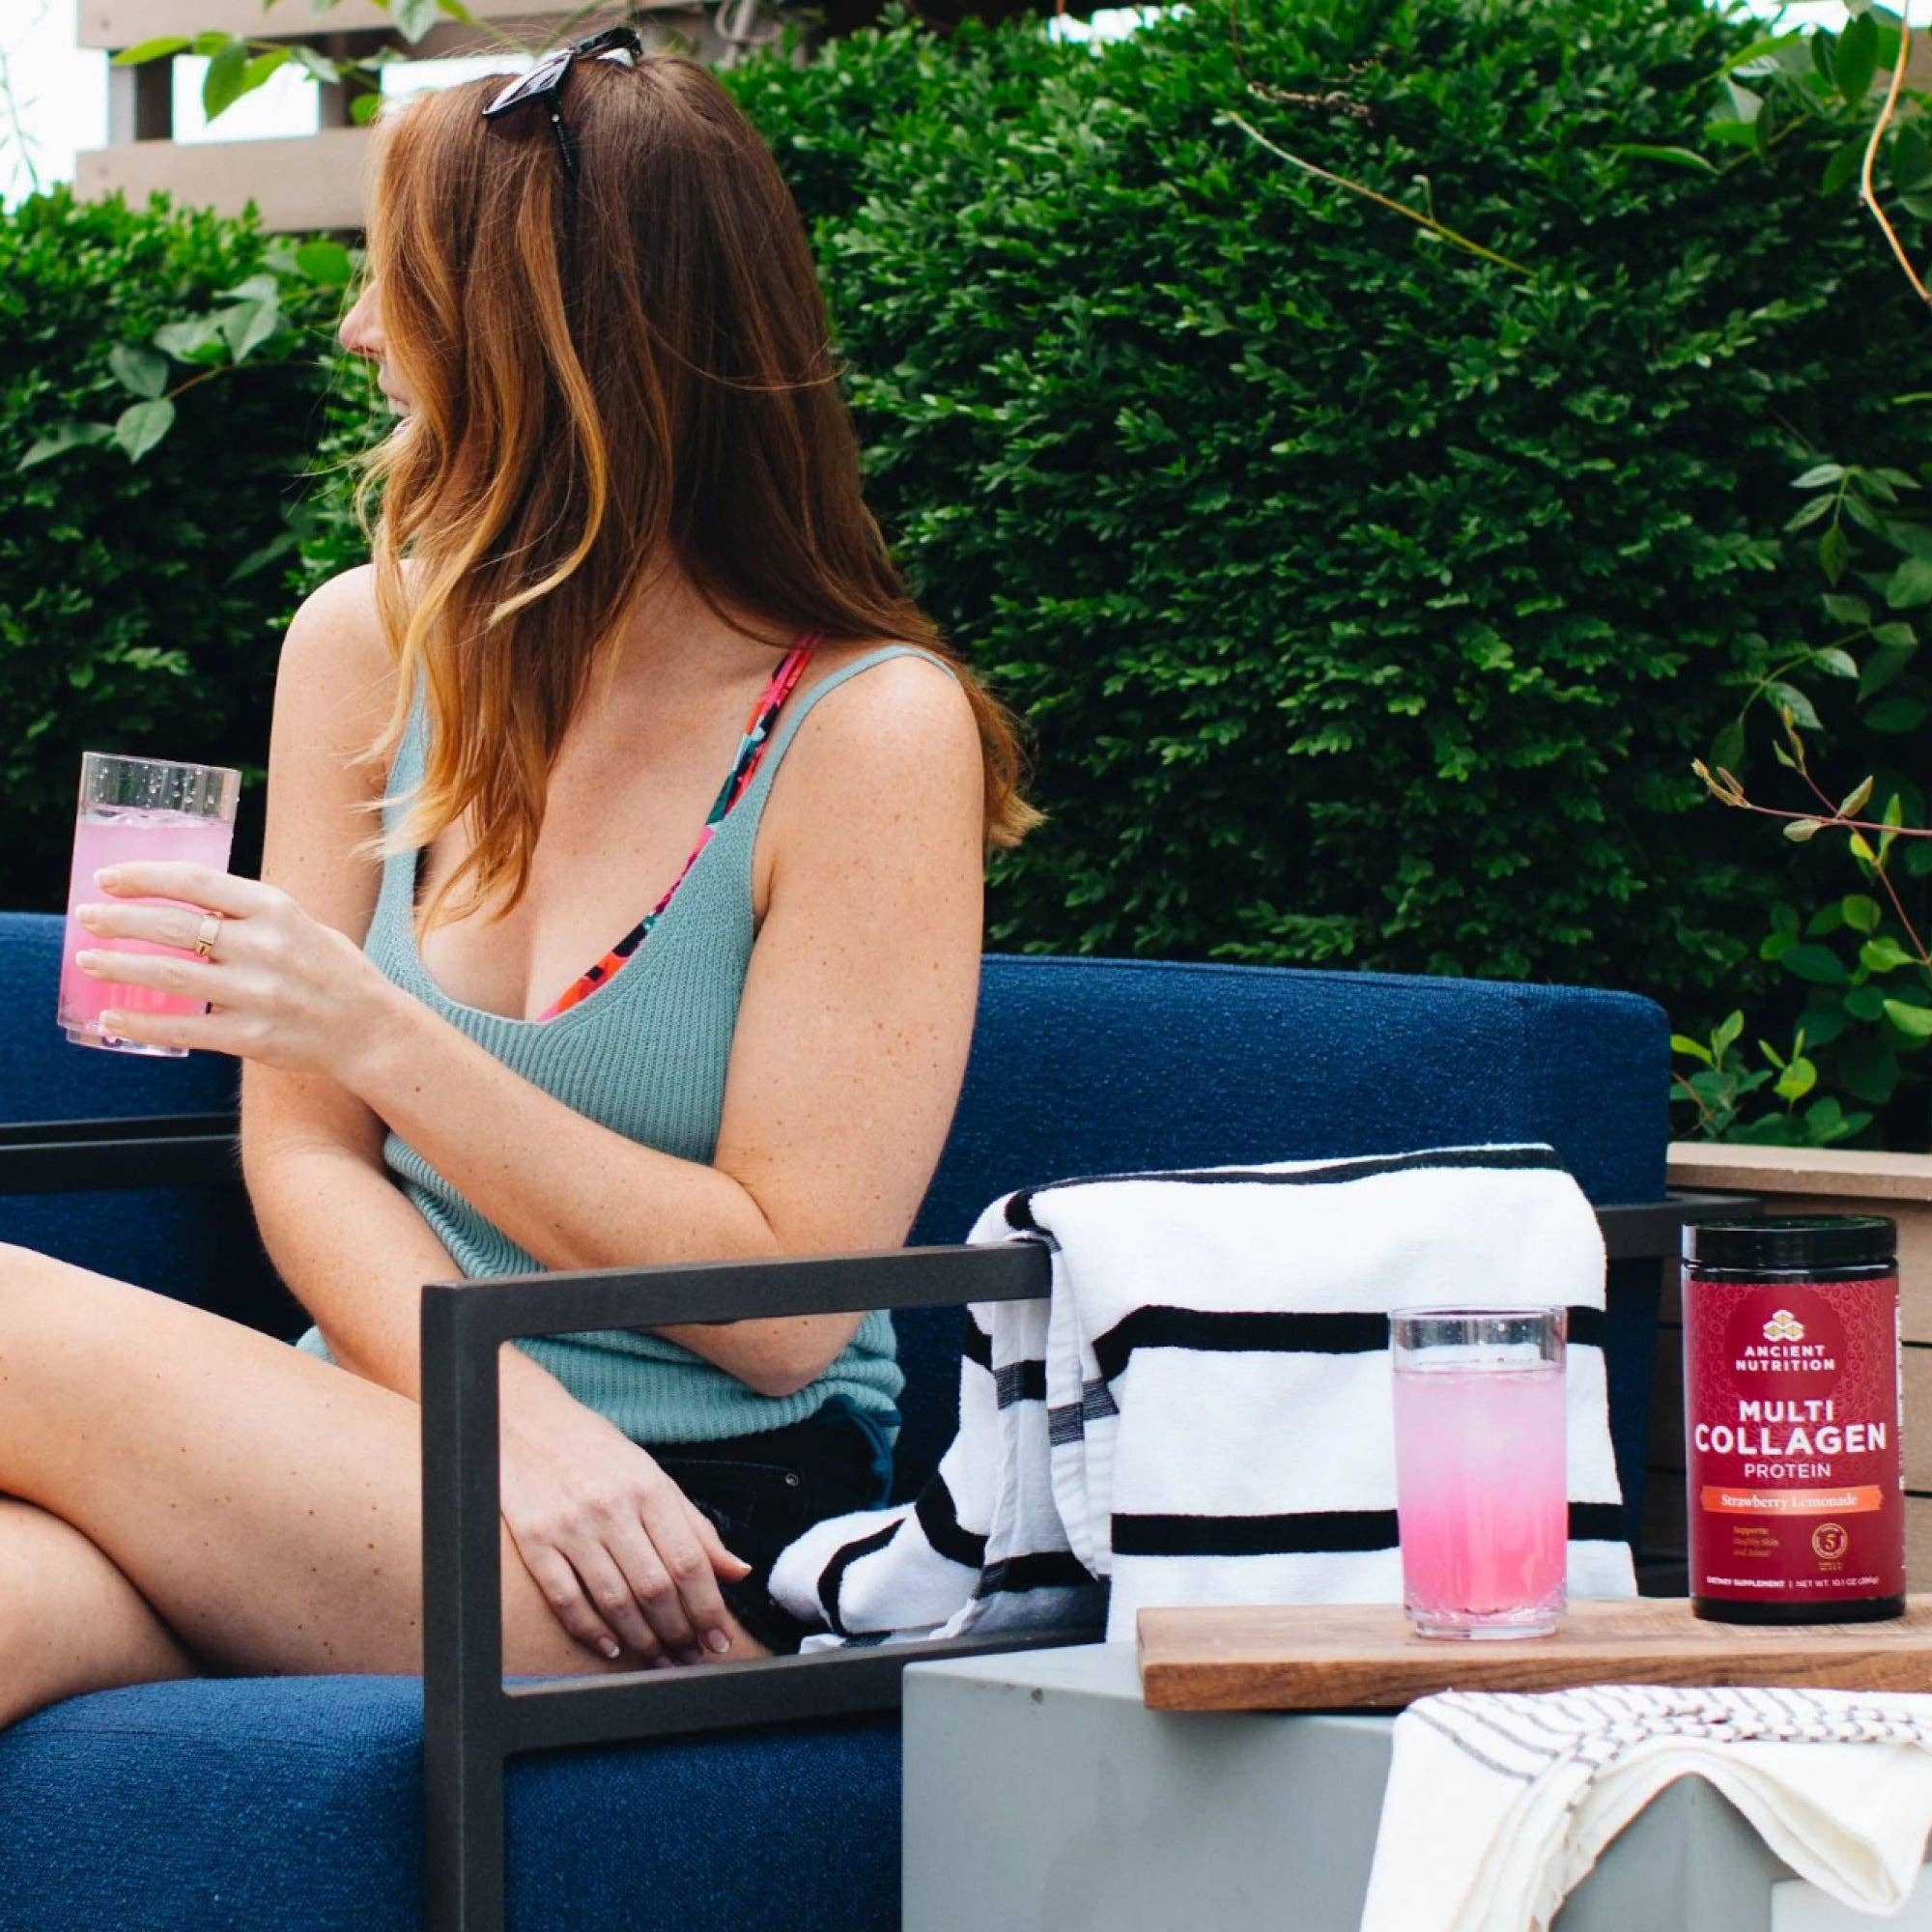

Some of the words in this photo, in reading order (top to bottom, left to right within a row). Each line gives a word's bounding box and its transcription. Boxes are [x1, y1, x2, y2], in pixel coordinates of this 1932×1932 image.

[1745, 1345, 1825, 1357] ANCIENT
[1736, 1358, 1835, 1372] NUTRITION
[1740, 1400, 1834, 1422] MULTI
[1694, 1423, 1887, 1455] COLLAGEN
[1744, 1463, 1832, 1479] PROTEIN
[1720, 1493, 1787, 1510] Strawberry
[1792, 1492, 1859, 1508] Lemonade
